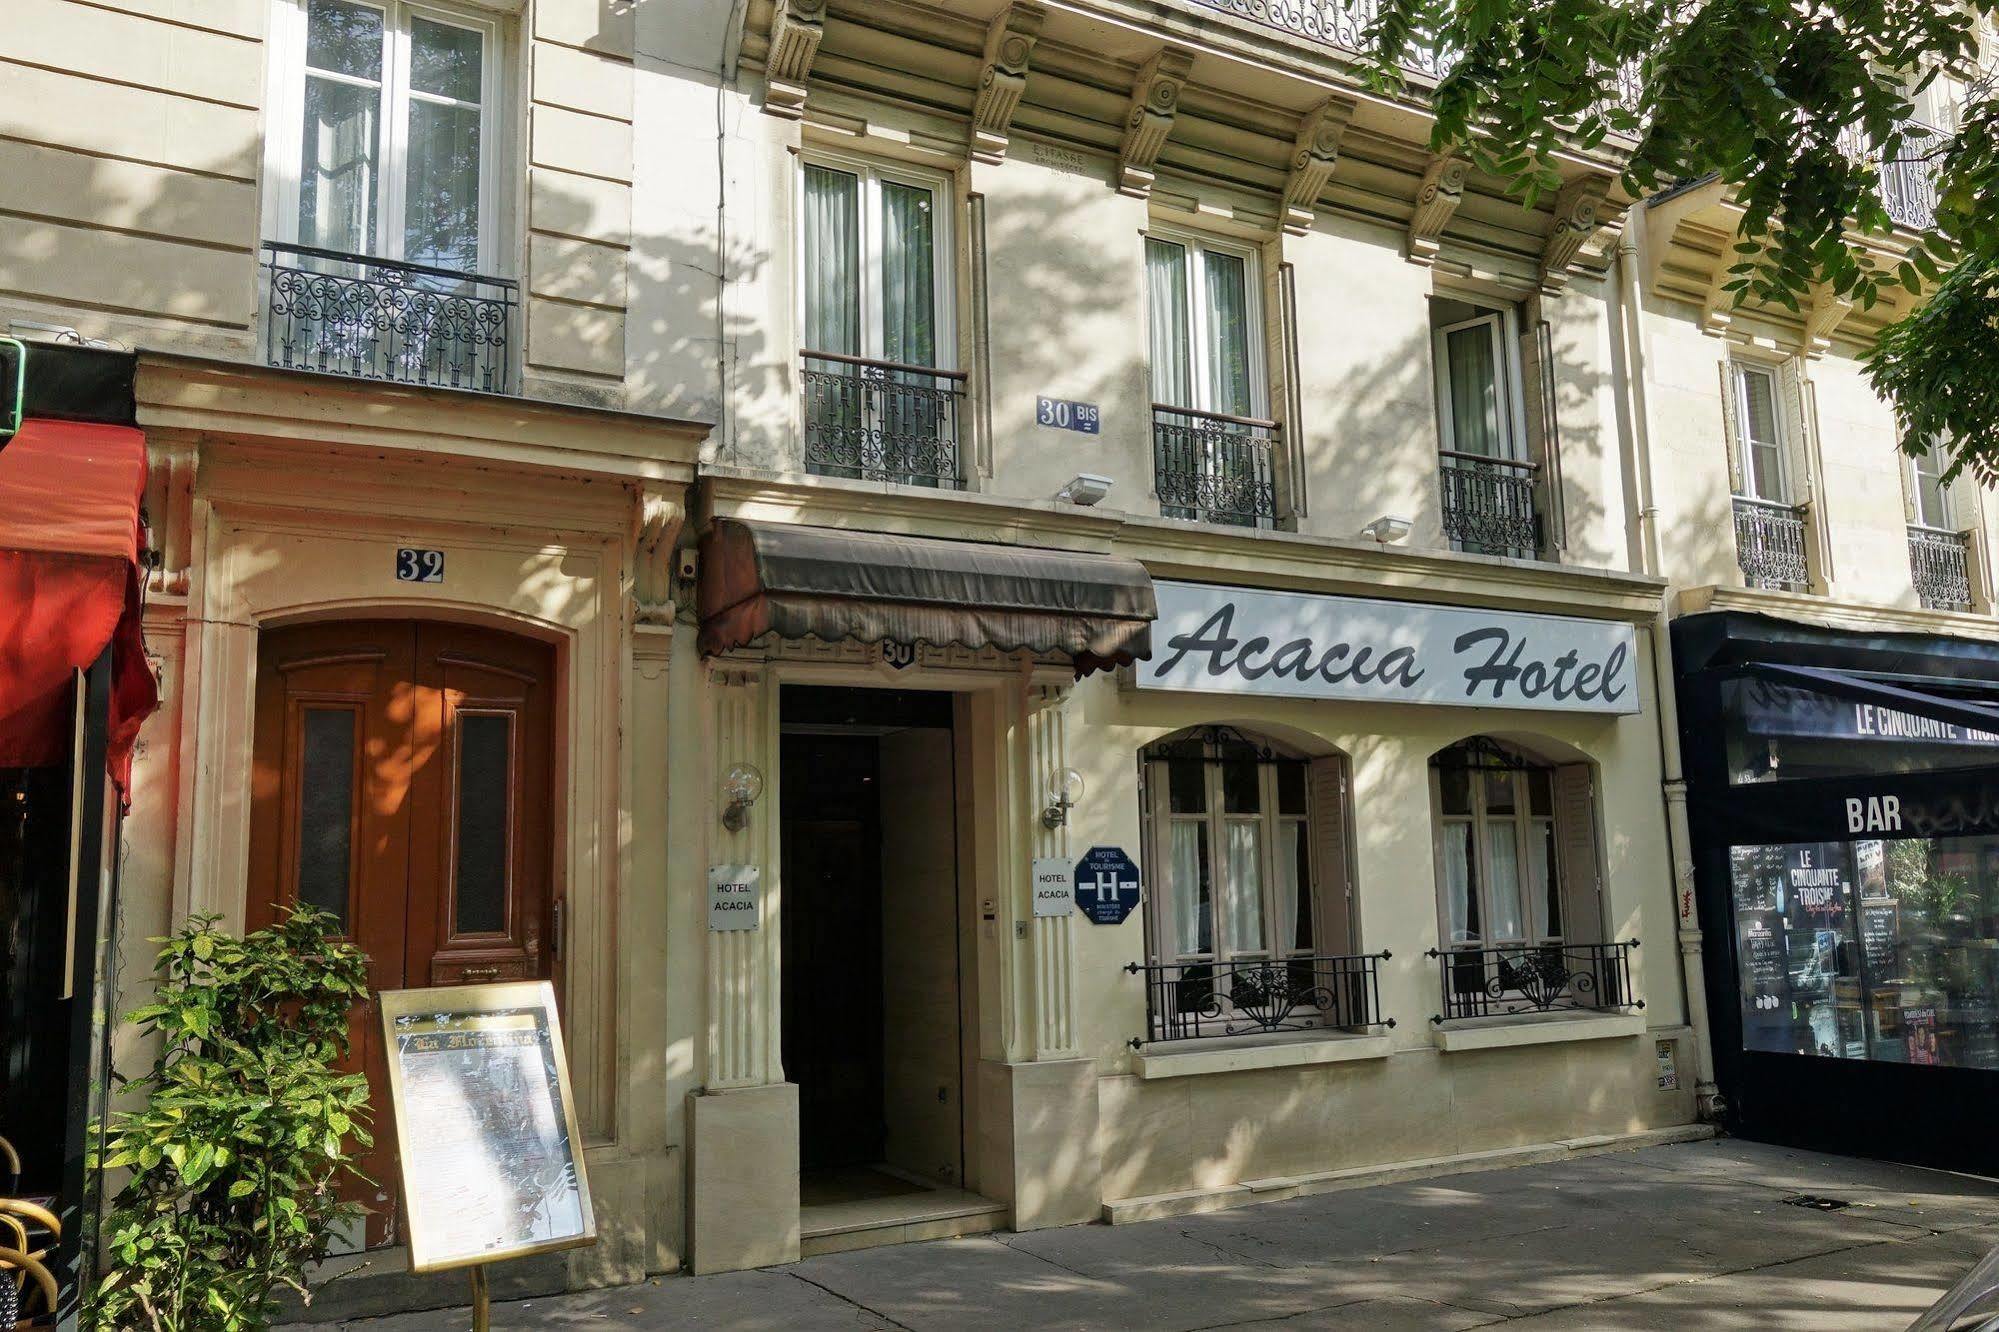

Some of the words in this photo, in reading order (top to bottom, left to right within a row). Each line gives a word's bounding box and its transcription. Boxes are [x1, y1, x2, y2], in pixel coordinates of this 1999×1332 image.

[1041, 399, 1070, 427] 30
[1076, 405, 1097, 421] BIS
[400, 549, 442, 582] 32
[1154, 603, 1424, 688] Acacia
[1453, 626, 1627, 703] Hotel
[1855, 703, 1876, 735] LE
[1845, 795, 1902, 833] BAR
[1800, 850, 1811, 868] LE
[717, 883, 751, 893] HOTEL
[1039, 874, 1067, 883] HOTEL
[1096, 871, 1120, 902] H
[1790, 868, 1839, 887] CINQUANTE
[714, 901, 754, 911] ACACIA
[1038, 890, 1070, 899] ACACIA
